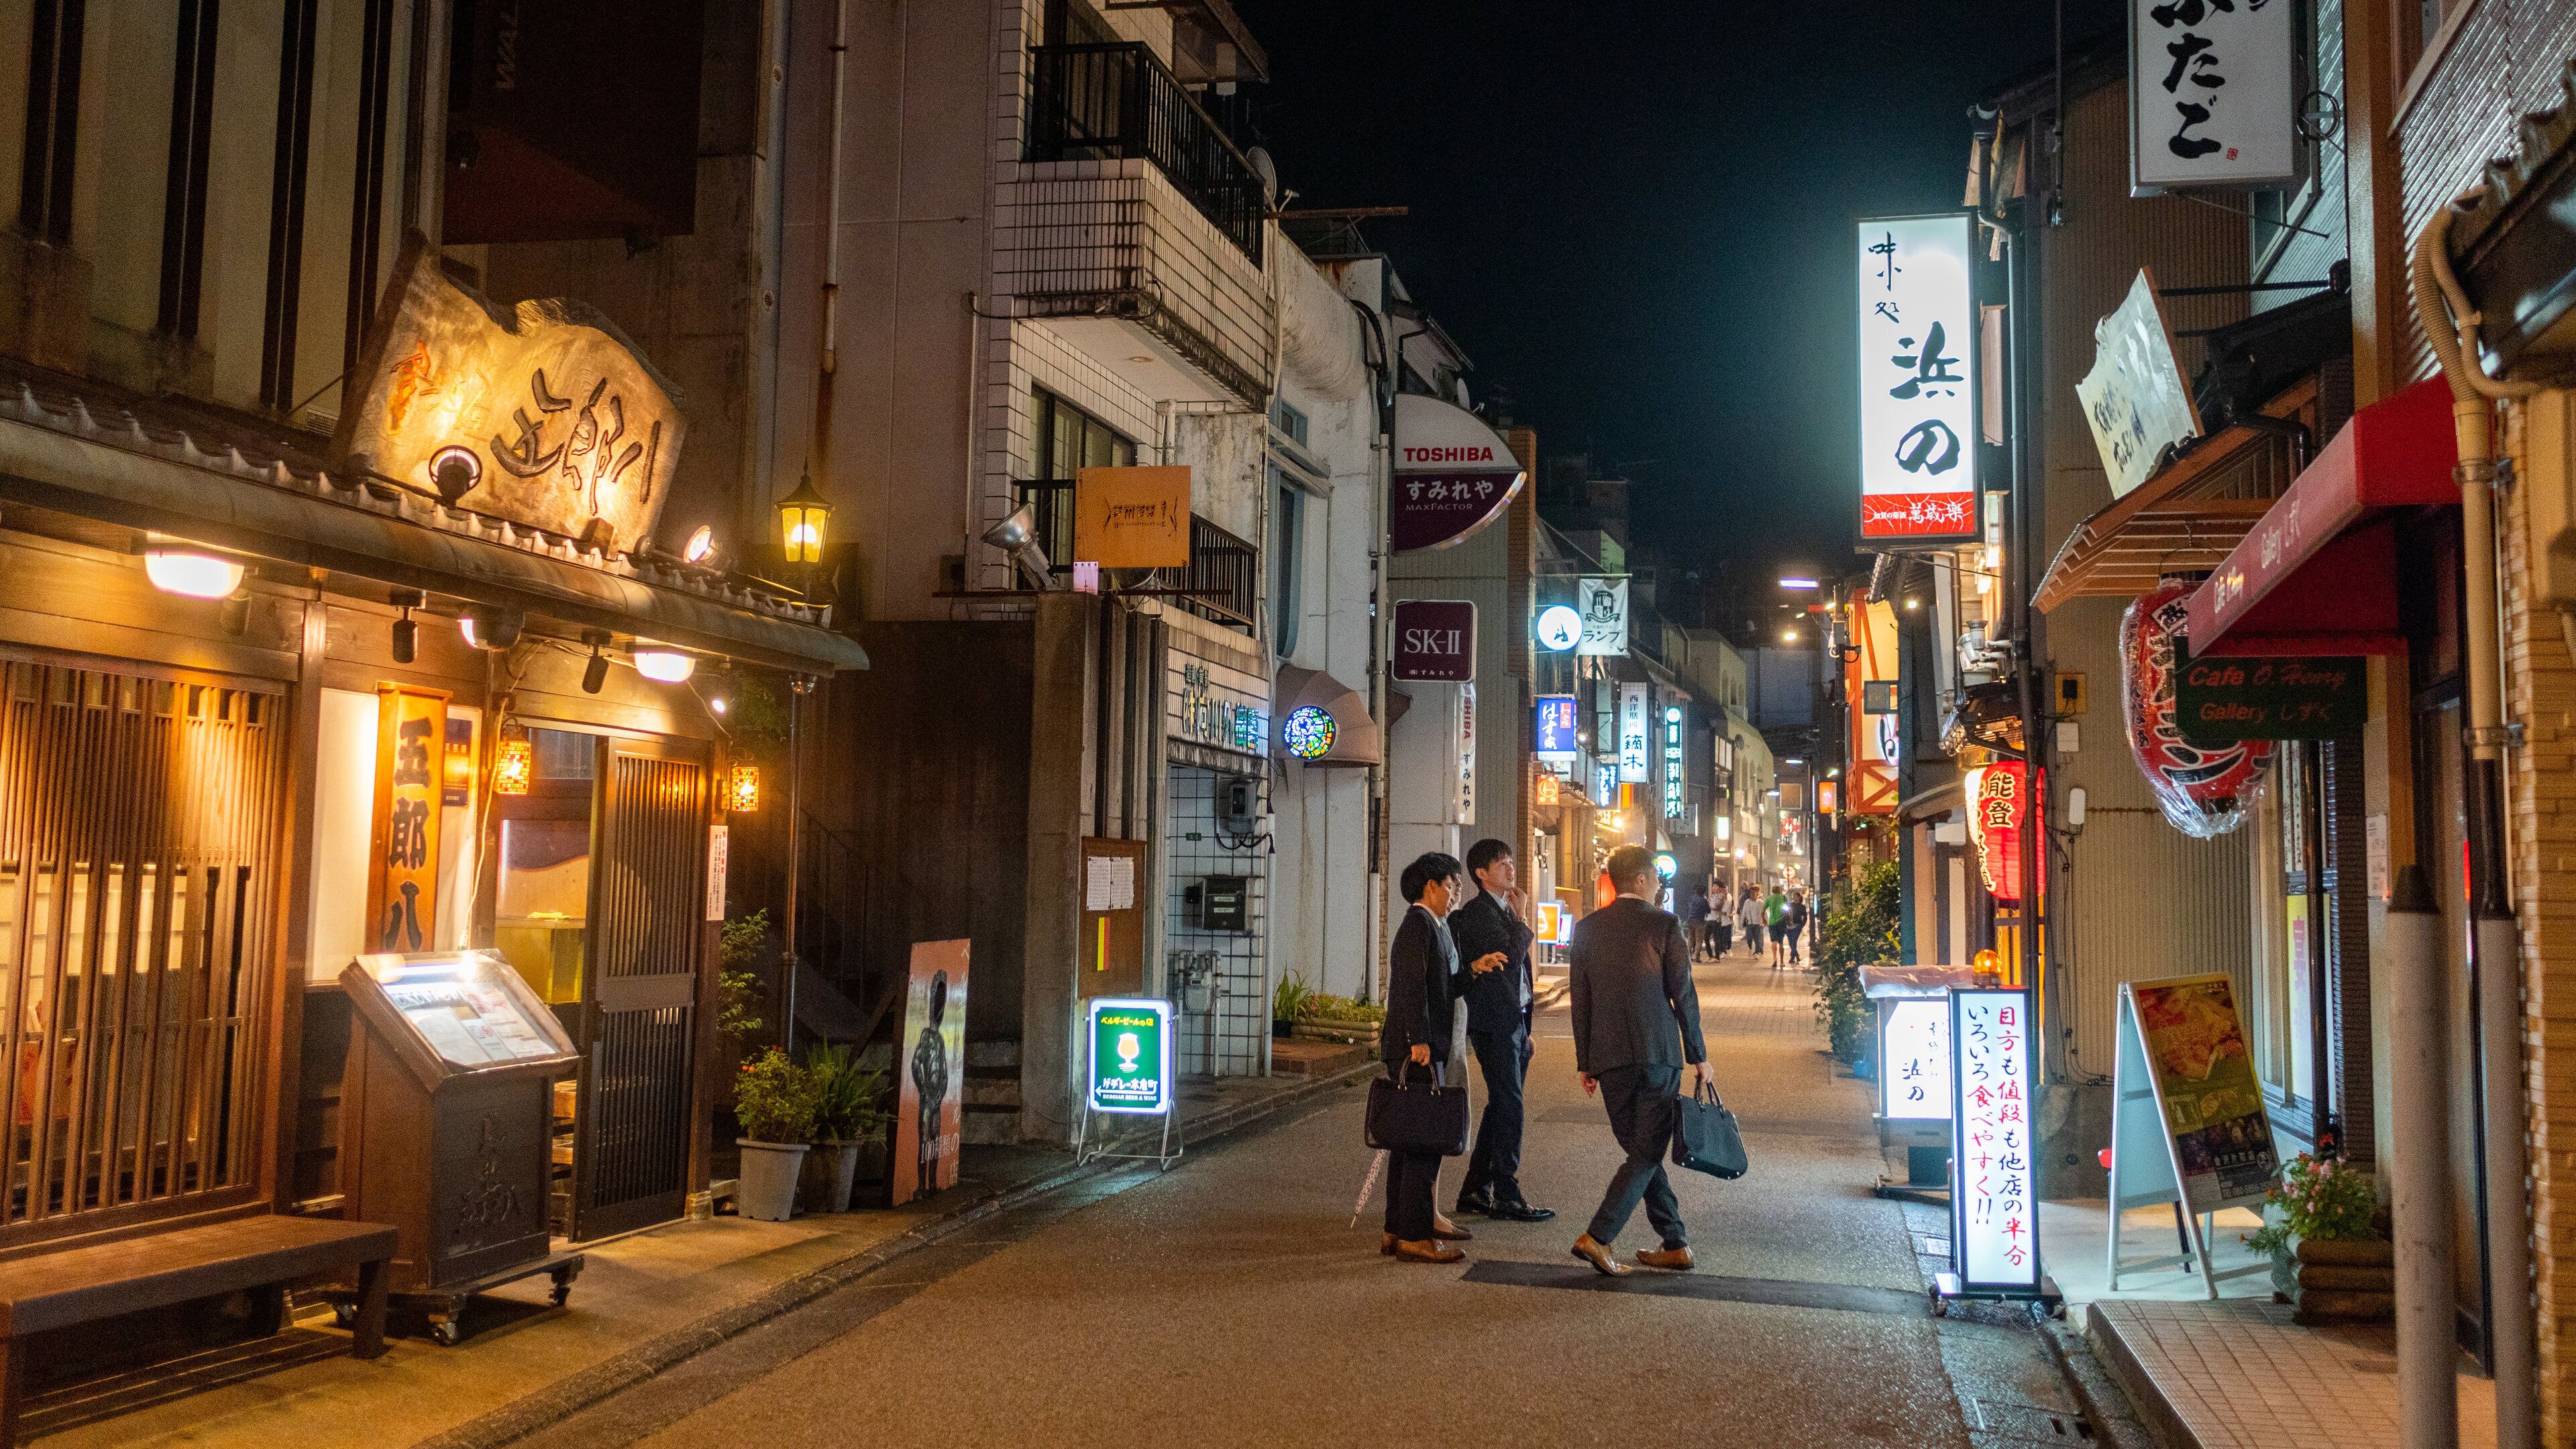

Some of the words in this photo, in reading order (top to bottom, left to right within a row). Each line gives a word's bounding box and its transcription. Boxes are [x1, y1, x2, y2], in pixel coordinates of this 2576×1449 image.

[1868, 231, 1902, 323] 味処
[1889, 321, 1965, 476] 浜の
[1403, 447, 1494, 462] TOSHIBA
[1407, 480, 1494, 500] すみれや
[1405, 503, 1473, 511] MAXFACTOR
[1404, 628, 1462, 655] SK-II
[1583, 629, 1622, 643] ランプ
[2189, 665, 2245, 686] Cafe
[1629, 694, 1639, 728] 西洋膳所
[2200, 702, 2267, 724] Gallery
[1462, 753, 1471, 810] すみれや
[1986, 771, 2015, 828] 能登
[384, 716, 433, 951] 五郎八
[1100, 1016, 1155, 1027] ベルギービールの店
[1902, 1058, 1925, 1102] 浜の
[1996, 1006, 2028, 1267] 目方も値段も他店の半分
